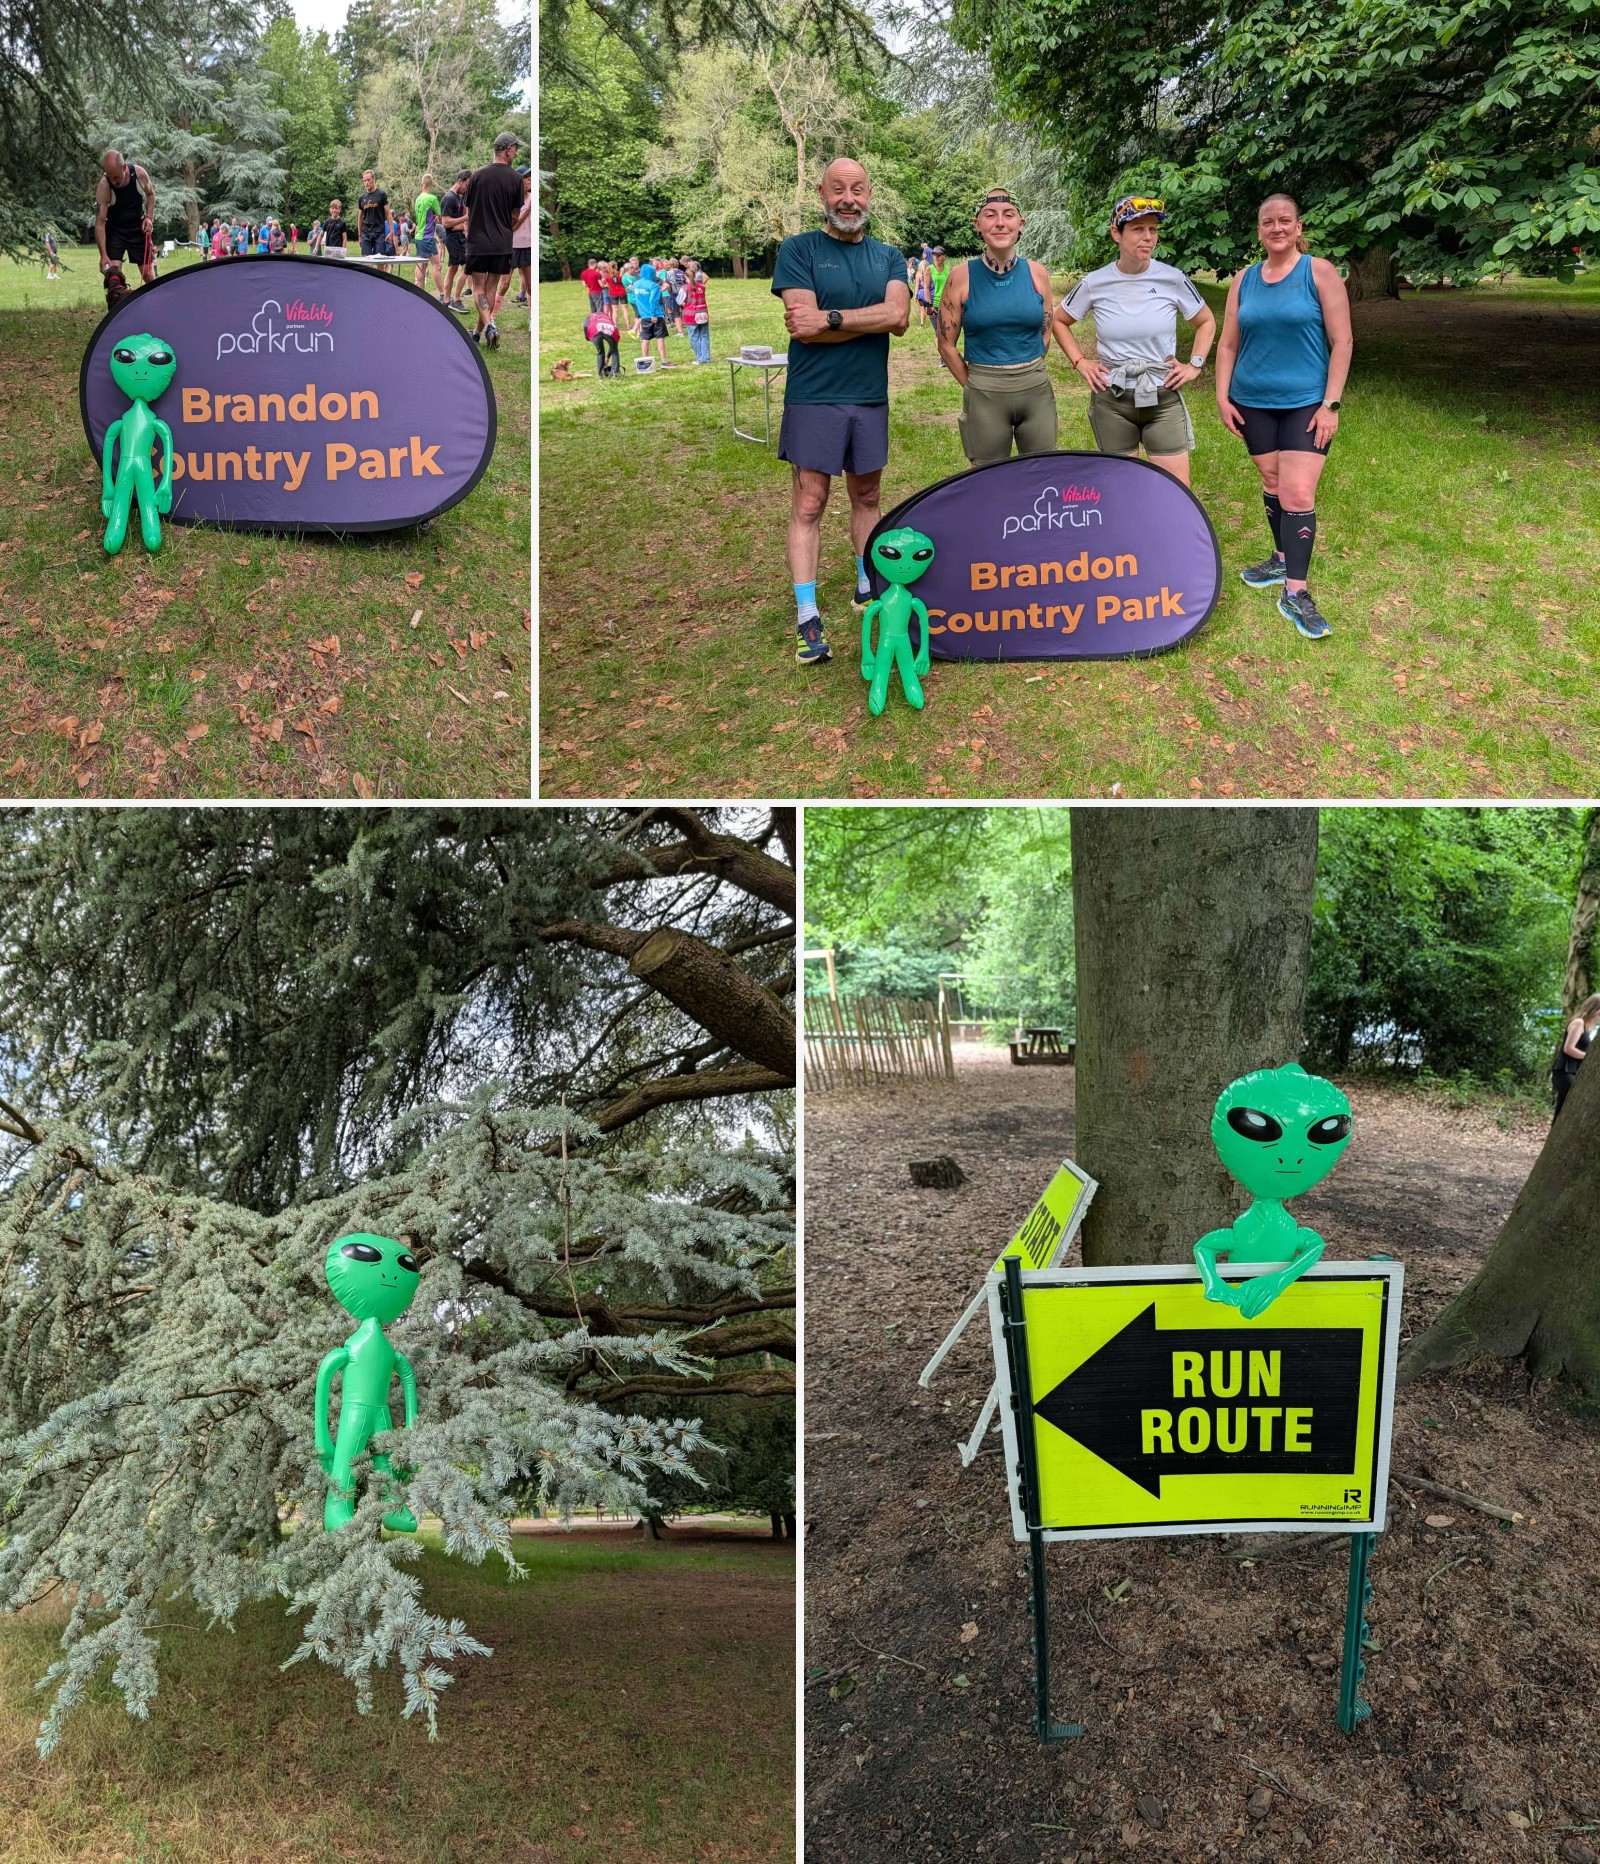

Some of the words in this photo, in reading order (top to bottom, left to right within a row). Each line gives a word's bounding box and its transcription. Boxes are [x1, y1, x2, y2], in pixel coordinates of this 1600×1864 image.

[217, 300, 334, 360] parkrun
[286, 299, 333, 328] Vitality
[182, 384, 379, 423] Brandon
[152, 446, 311, 491] ountry
[326, 436, 444, 481] Park
[1002, 487, 1102, 539] parkrun
[1062, 485, 1101, 506] Vitality
[970, 551, 1137, 591] Brandon
[928, 602, 1085, 634] Country
[1096, 587, 1186, 625] Park
[1020, 1201, 1061, 1269] START
[1172, 1350, 1282, 1398] RUN
[1141, 1407, 1314, 1454] ROUTE
